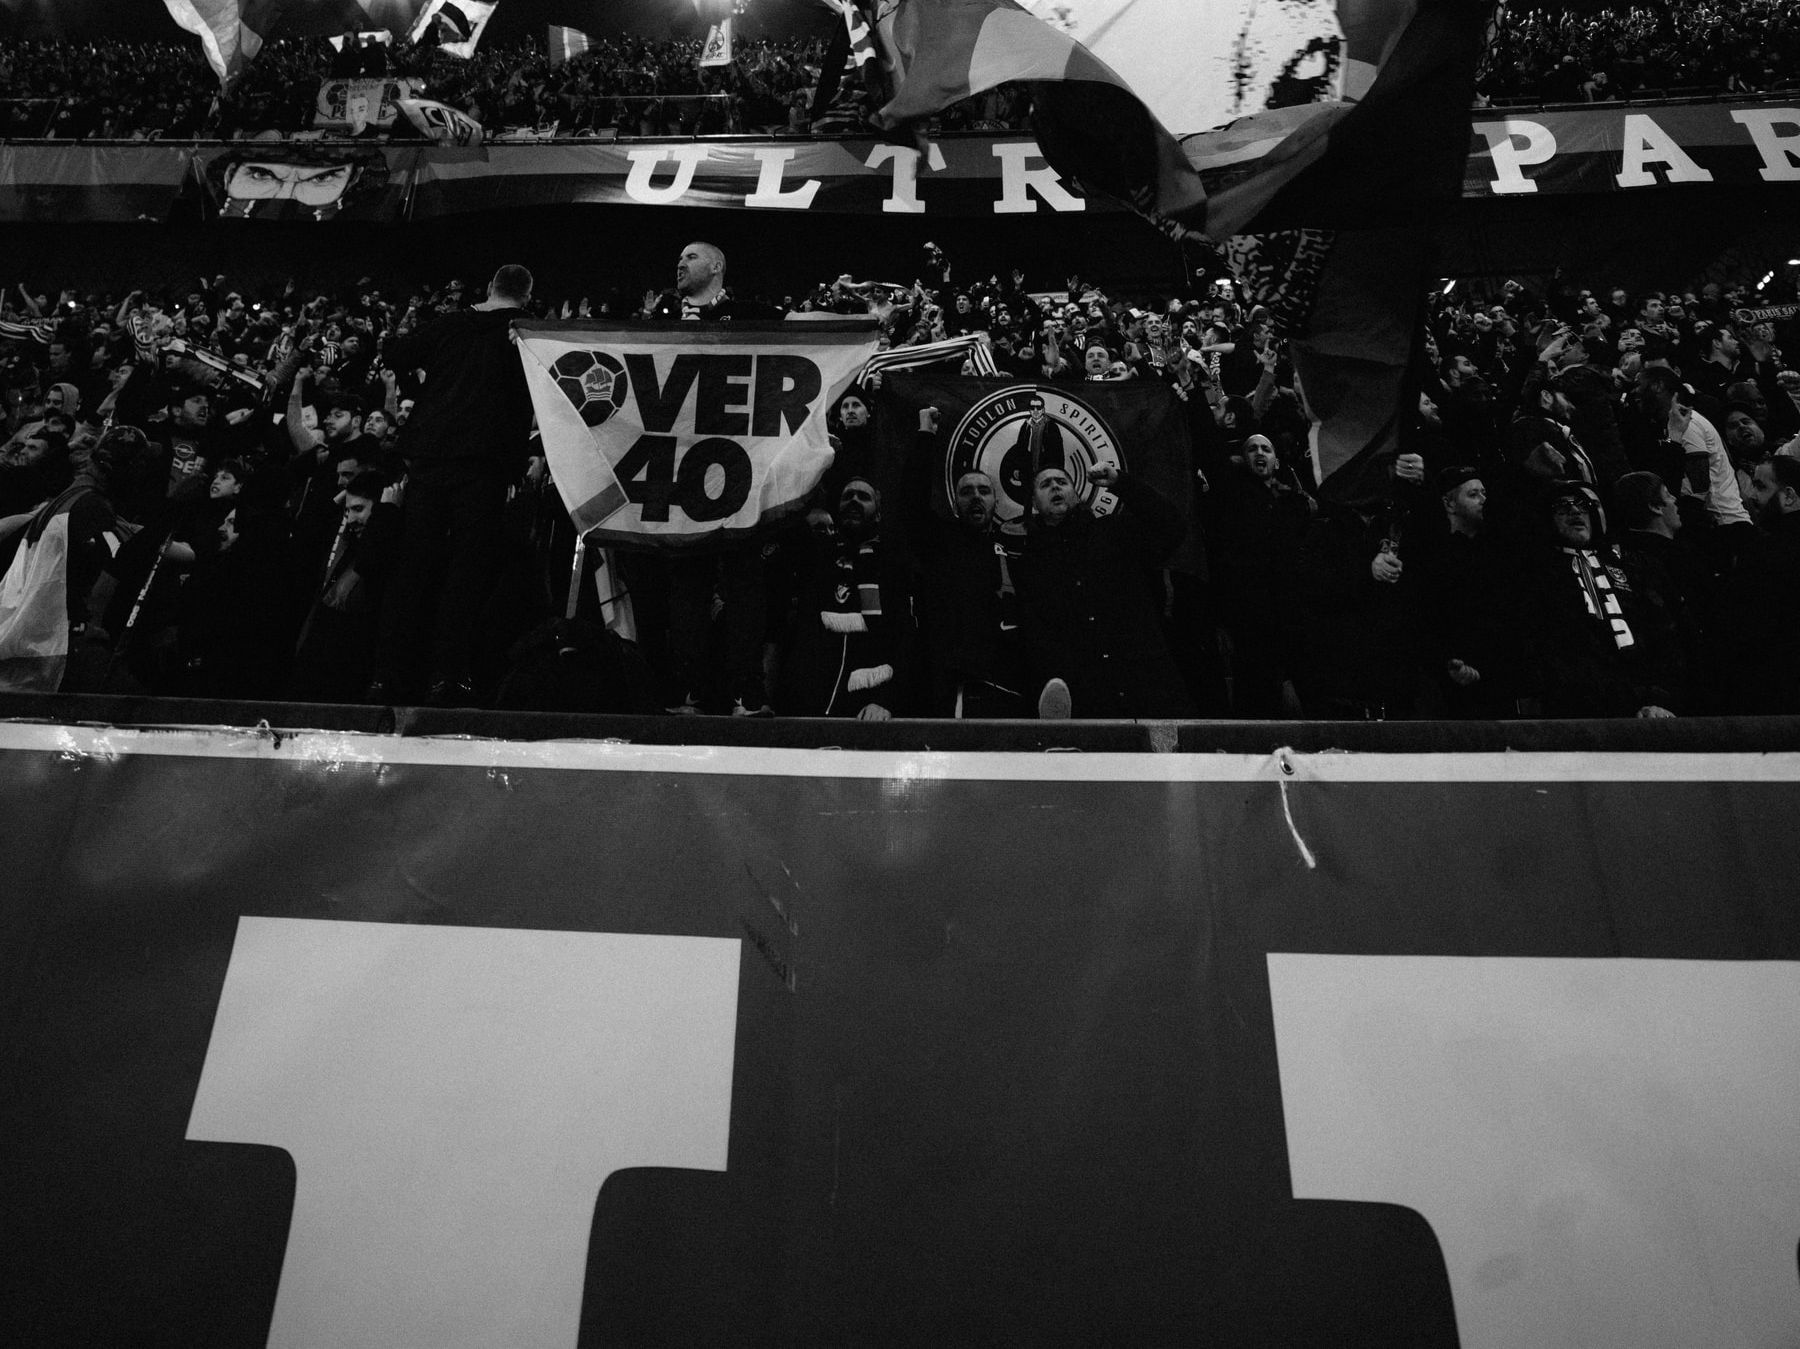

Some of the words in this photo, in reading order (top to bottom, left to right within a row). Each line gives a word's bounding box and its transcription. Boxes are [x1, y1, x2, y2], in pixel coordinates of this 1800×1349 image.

[962, 398, 1016, 448] TOULON
[1060, 402, 1109, 450] SPIRIT
[614, 435, 752, 522] 40
